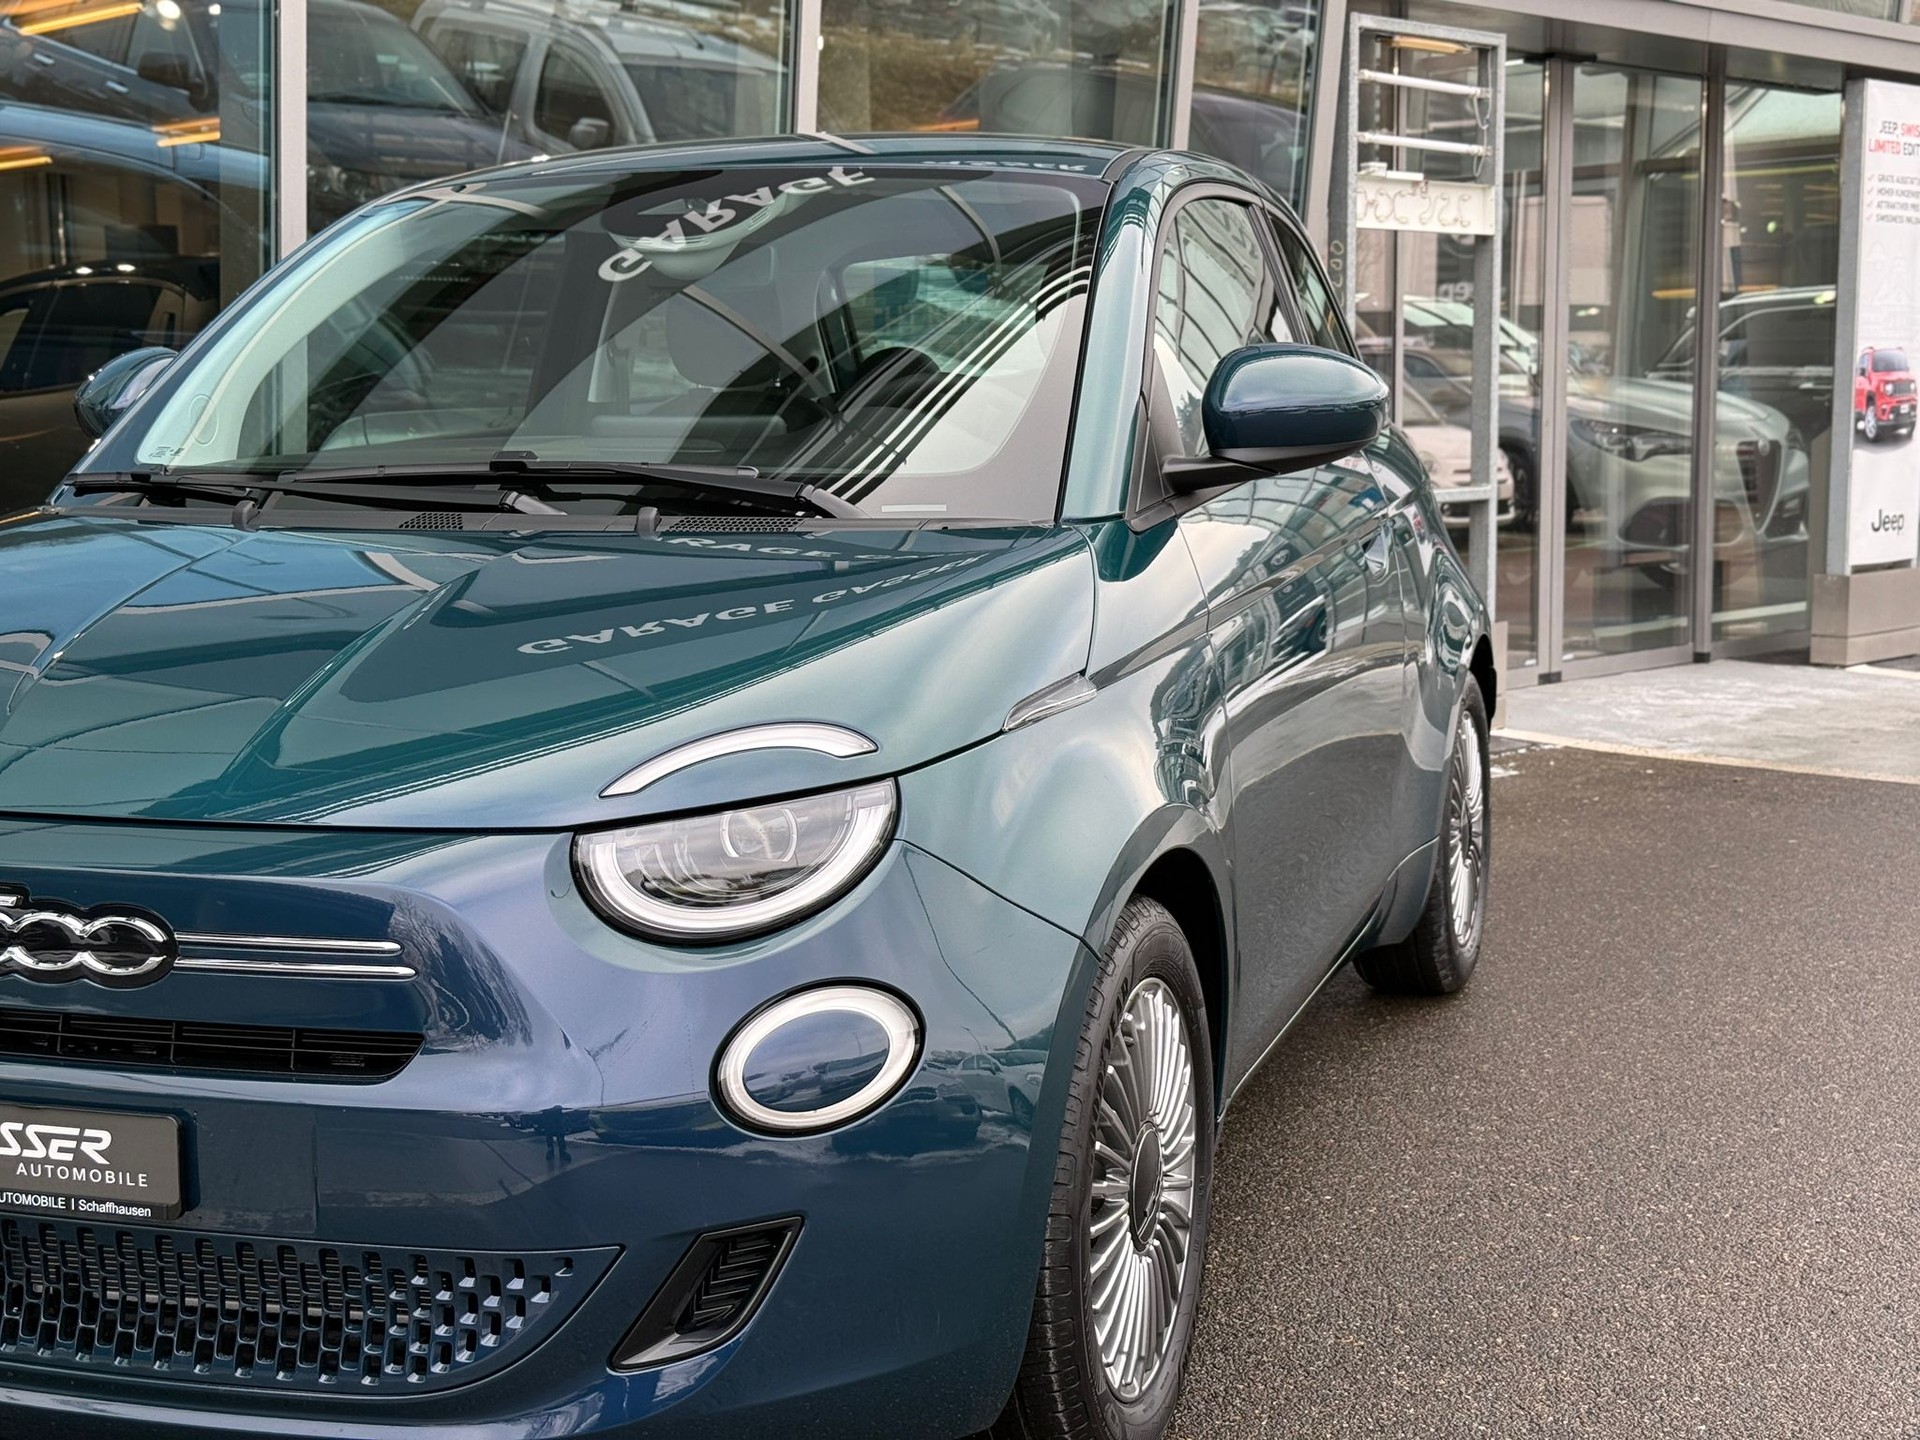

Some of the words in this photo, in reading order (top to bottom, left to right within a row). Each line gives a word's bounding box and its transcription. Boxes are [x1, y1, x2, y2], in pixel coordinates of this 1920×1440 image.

[1868, 138, 1901, 155] LIMITED
[1871, 509, 1904, 535] Jeep
[16, 1162, 148, 1188] AUTOMOBILE
[78, 1199, 151, 1217] Schaffhausen
